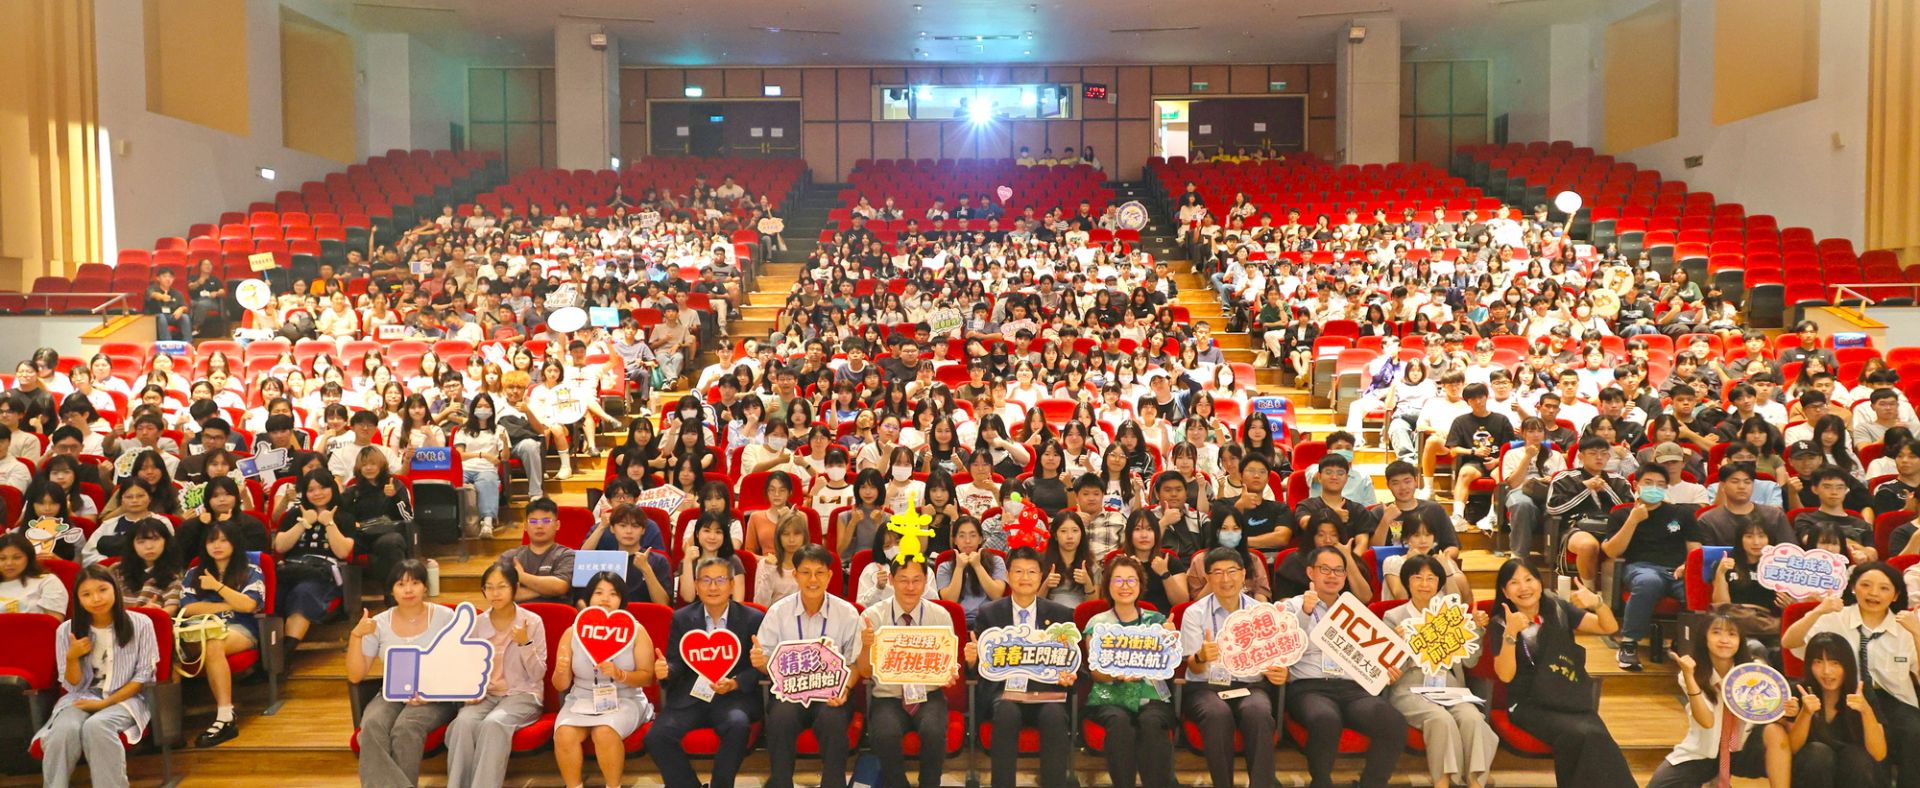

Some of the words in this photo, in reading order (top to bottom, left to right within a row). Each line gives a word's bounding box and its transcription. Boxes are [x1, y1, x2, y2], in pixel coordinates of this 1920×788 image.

[1774, 556, 1833, 575] 一起成為
[1324, 626, 1382, 679] 國立嘉義大學
[1409, 605, 1464, 654] 向著夢想
